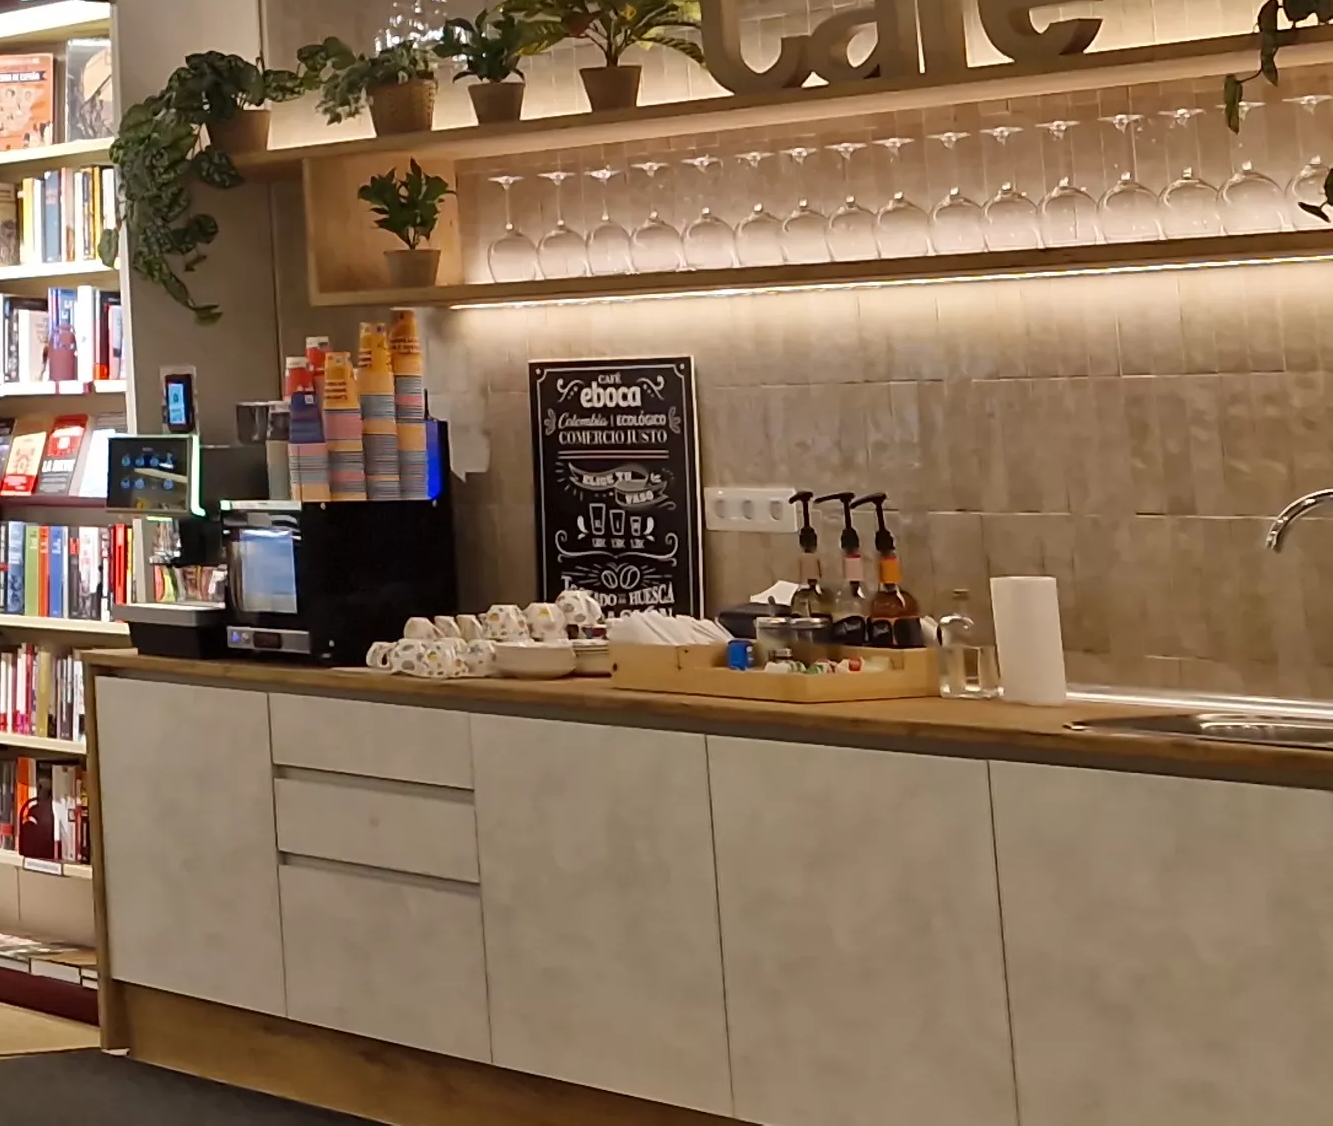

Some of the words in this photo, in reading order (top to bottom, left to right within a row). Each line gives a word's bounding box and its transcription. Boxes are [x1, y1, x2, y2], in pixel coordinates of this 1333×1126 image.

[597, 372, 622, 384] CAFÉ
[580, 380, 642, 409] eboca
[558, 411, 609, 429] Colombia
[616, 409, 667, 426] ECOLÓGICO
[558, 430, 625, 445] COMERCIO
[626, 429, 668, 445] JUSTO
[624, 489, 654, 505] VASO
[629, 581, 675, 605] HUESCA
